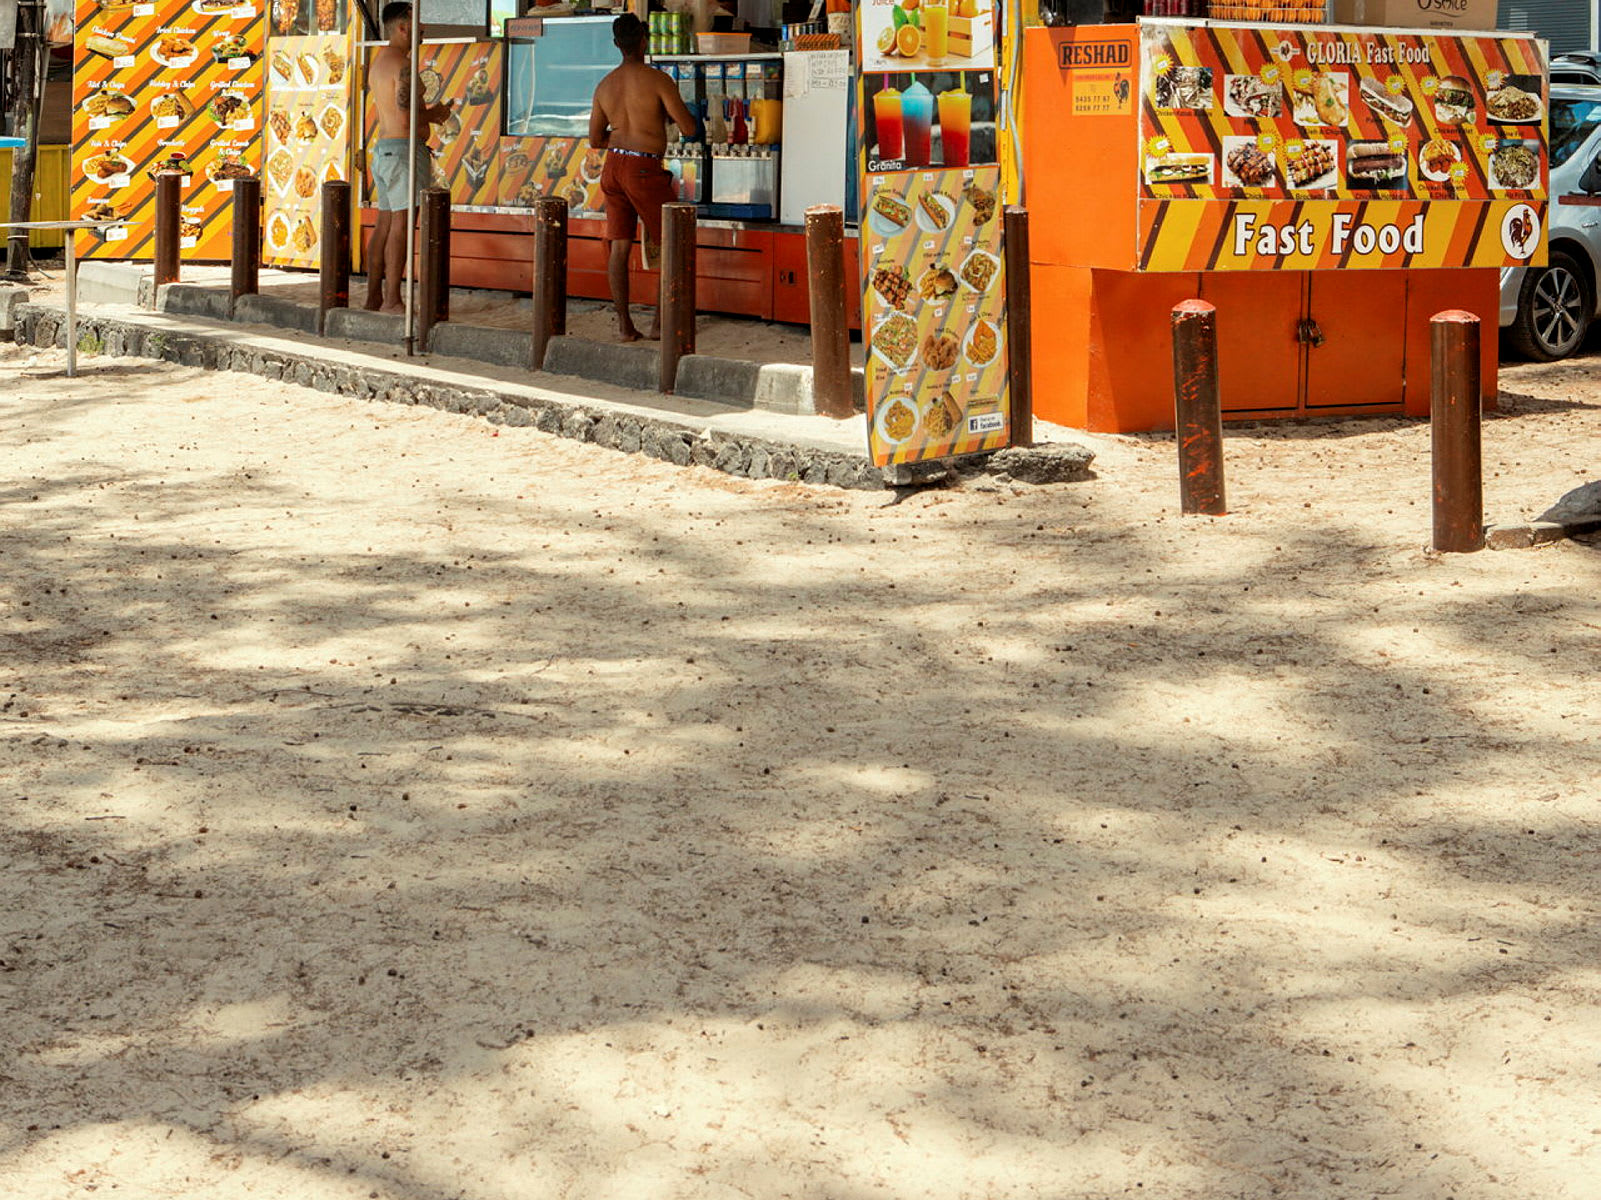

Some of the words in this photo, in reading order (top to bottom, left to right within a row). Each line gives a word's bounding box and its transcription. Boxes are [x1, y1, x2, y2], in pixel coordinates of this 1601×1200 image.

[1062, 44, 1129, 65] RESHAD
[1307, 41, 1361, 64] GLORIA
[1366, 42, 1394, 64] Fast
[1398, 42, 1430, 64] Food
[868, 160, 902, 172] Granita
[1233, 212, 1315, 256] Fast
[1331, 212, 1425, 256] Food
